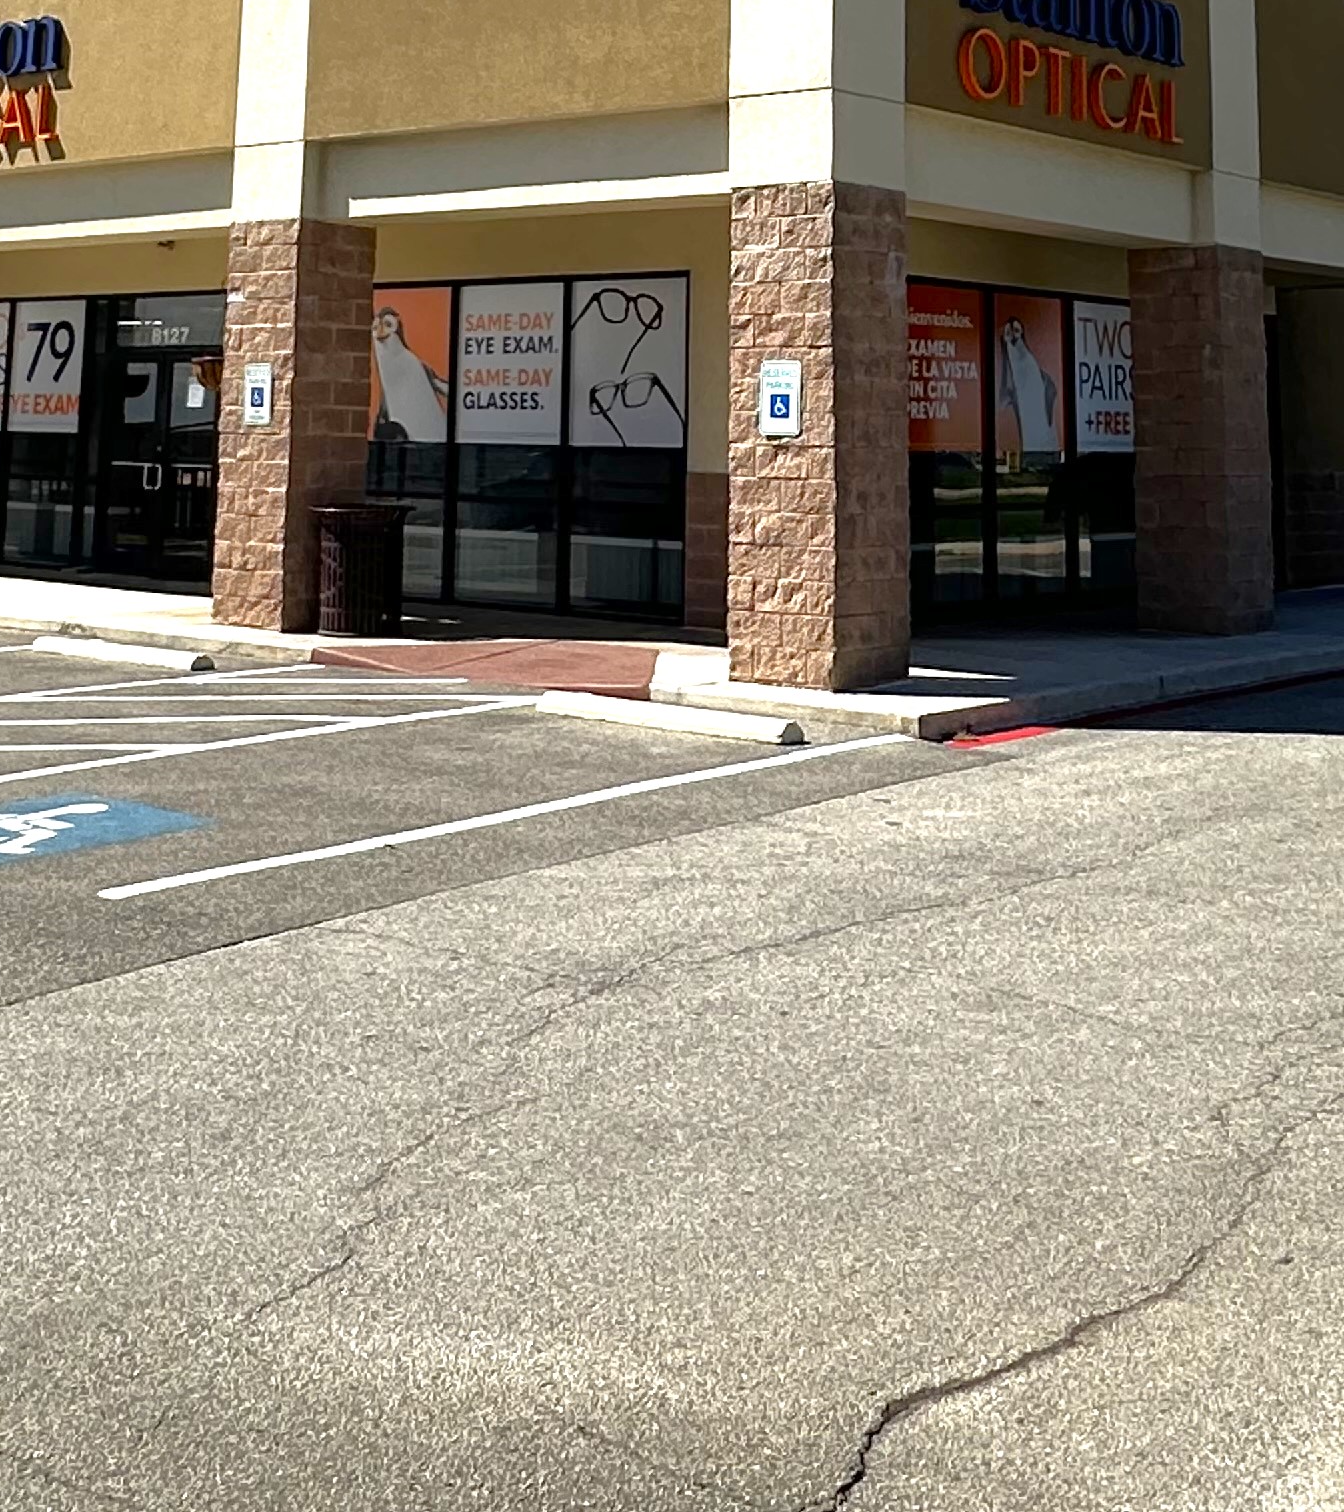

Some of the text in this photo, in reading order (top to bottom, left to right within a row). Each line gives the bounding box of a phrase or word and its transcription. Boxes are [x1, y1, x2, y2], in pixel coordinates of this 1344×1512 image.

[958, 28, 1184, 145] OPTICAL
[464, 312, 554, 332] SAME-DAY
[26, 320, 76, 382] 79
[464, 335, 559, 355] EYE EXAM.
[907, 339, 956, 358] XAMEN
[463, 368, 554, 387] SAME-DAY
[922, 360, 940, 378] LA
[942, 361, 978, 380] VISTA
[907, 380, 958, 399] IN CITA
[463, 391, 545, 410] GLASSES.
